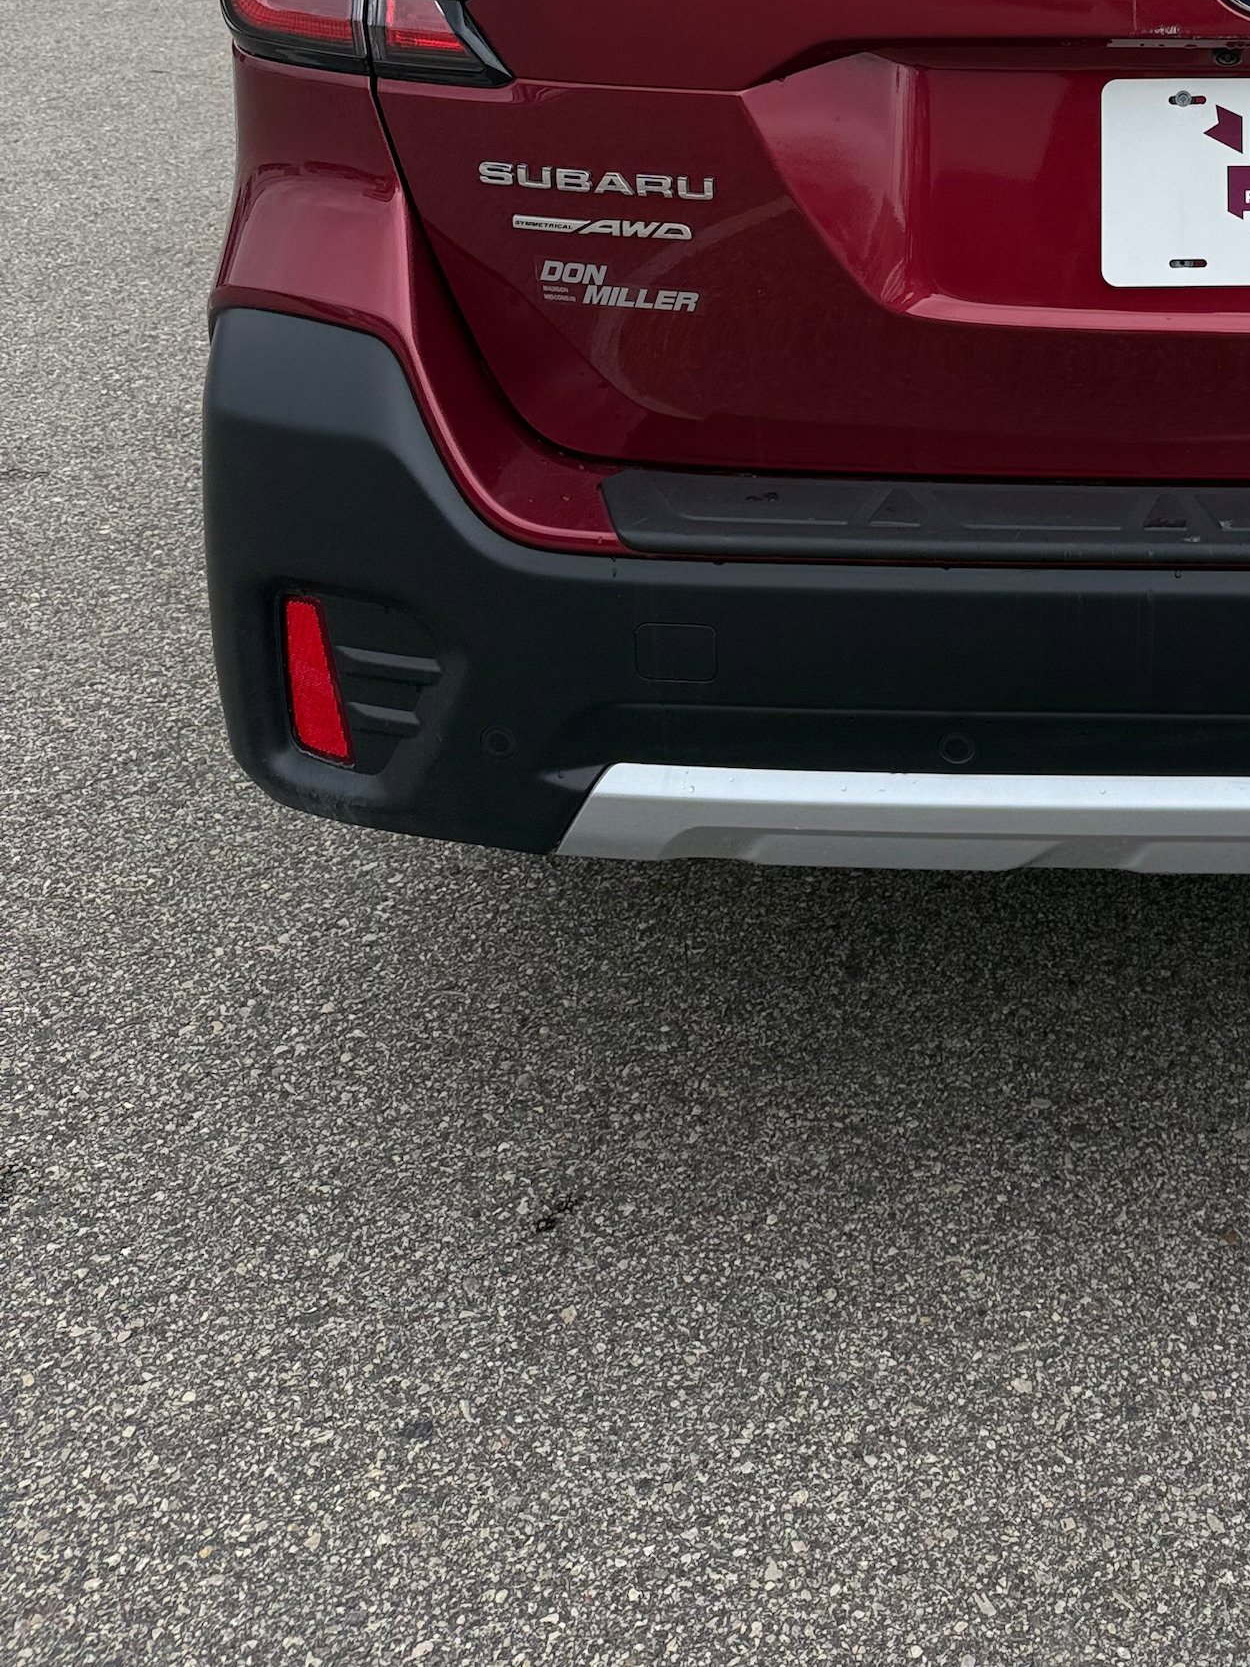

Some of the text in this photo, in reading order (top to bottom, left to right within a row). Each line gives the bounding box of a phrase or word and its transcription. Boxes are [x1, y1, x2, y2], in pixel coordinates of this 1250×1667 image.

[478, 161, 715, 201] SUBARU
[514, 219, 692, 240] SYMMETRICAL AWD
[540, 260, 608, 285] DON
[582, 284, 700, 312] MILLER
